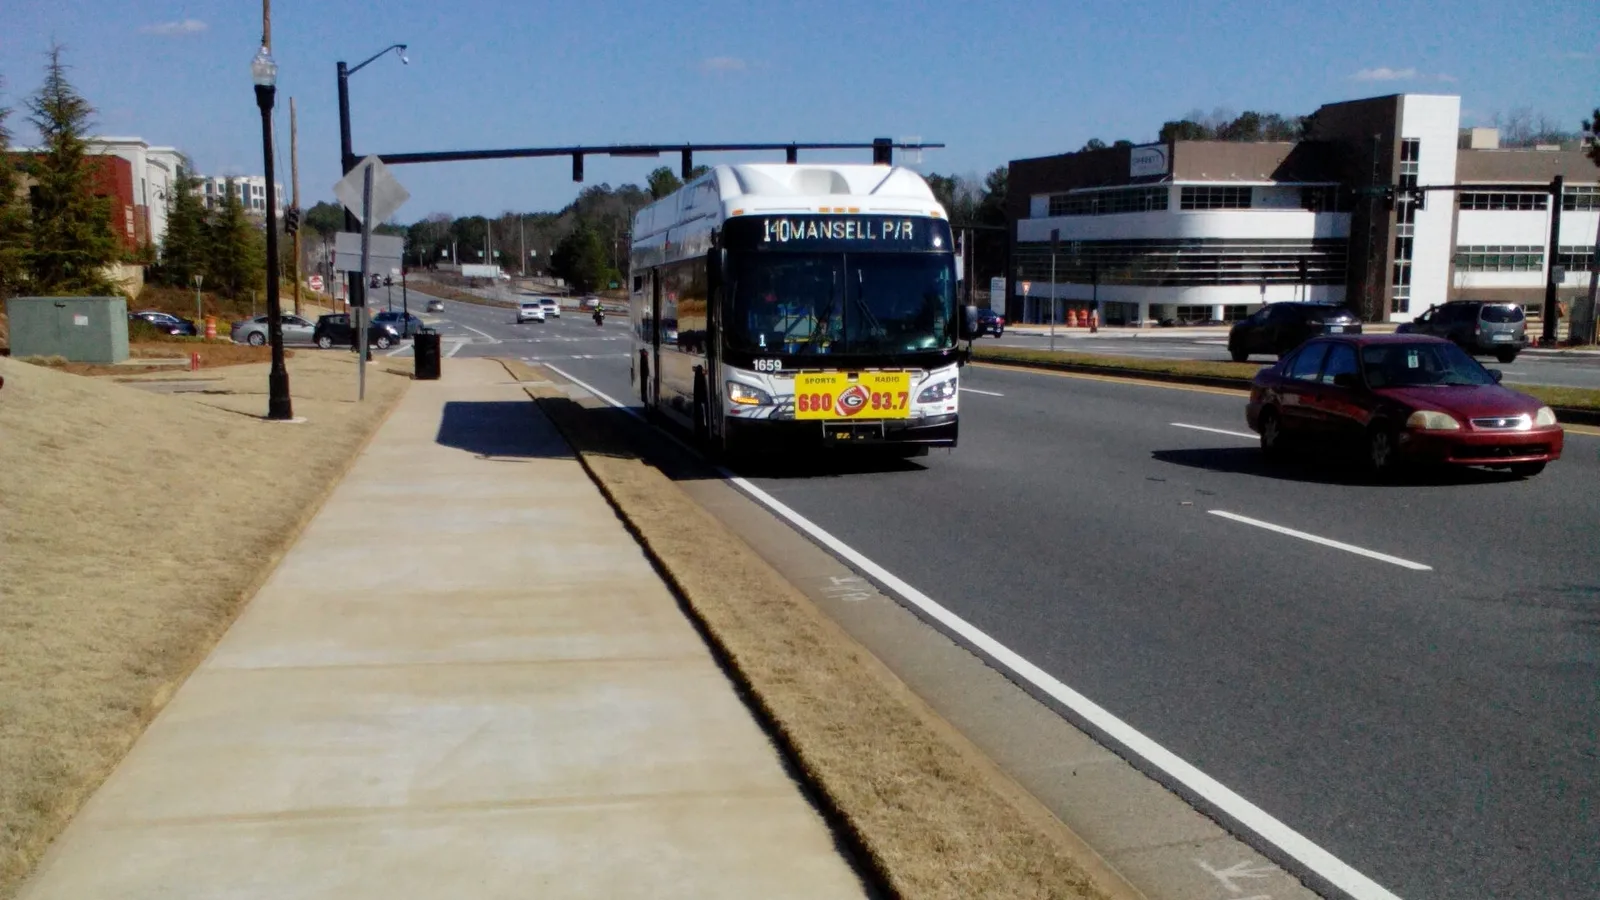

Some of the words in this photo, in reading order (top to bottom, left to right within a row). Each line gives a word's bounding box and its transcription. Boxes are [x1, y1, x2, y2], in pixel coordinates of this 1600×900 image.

[764, 220, 789, 242] 140
[790, 221, 876, 240] MANSELL
[883, 221, 913, 240] P/R
[752, 359, 782, 371] 1659
[798, 393, 832, 412] 680
[871, 392, 908, 410] 93.7
